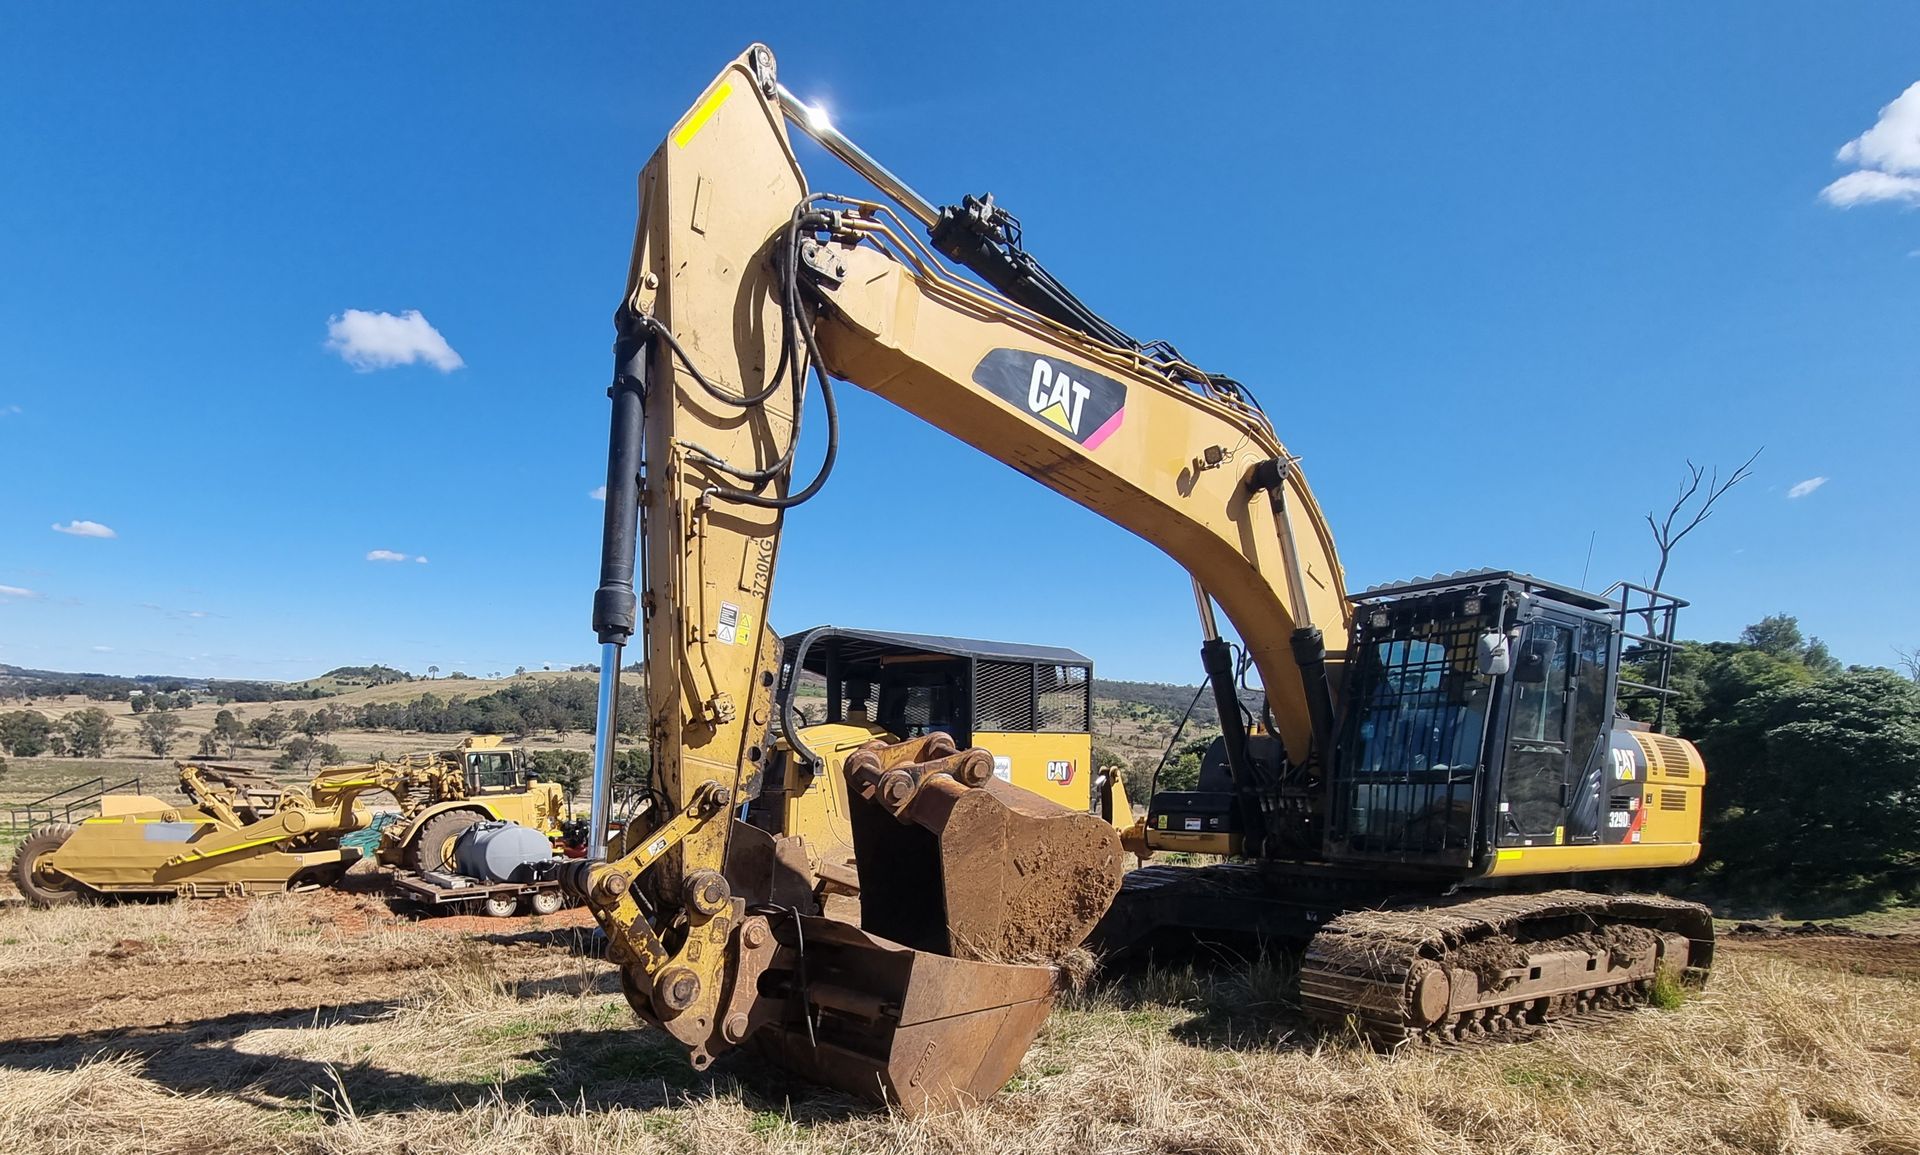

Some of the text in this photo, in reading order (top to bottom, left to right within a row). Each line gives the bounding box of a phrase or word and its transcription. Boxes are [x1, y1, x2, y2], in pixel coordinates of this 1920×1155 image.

[1028, 358, 1091, 436] CAT
[751, 539, 773, 600] 3730KG
[1047, 761, 1069, 780] CAT
[1612, 748, 1636, 780] CAT
